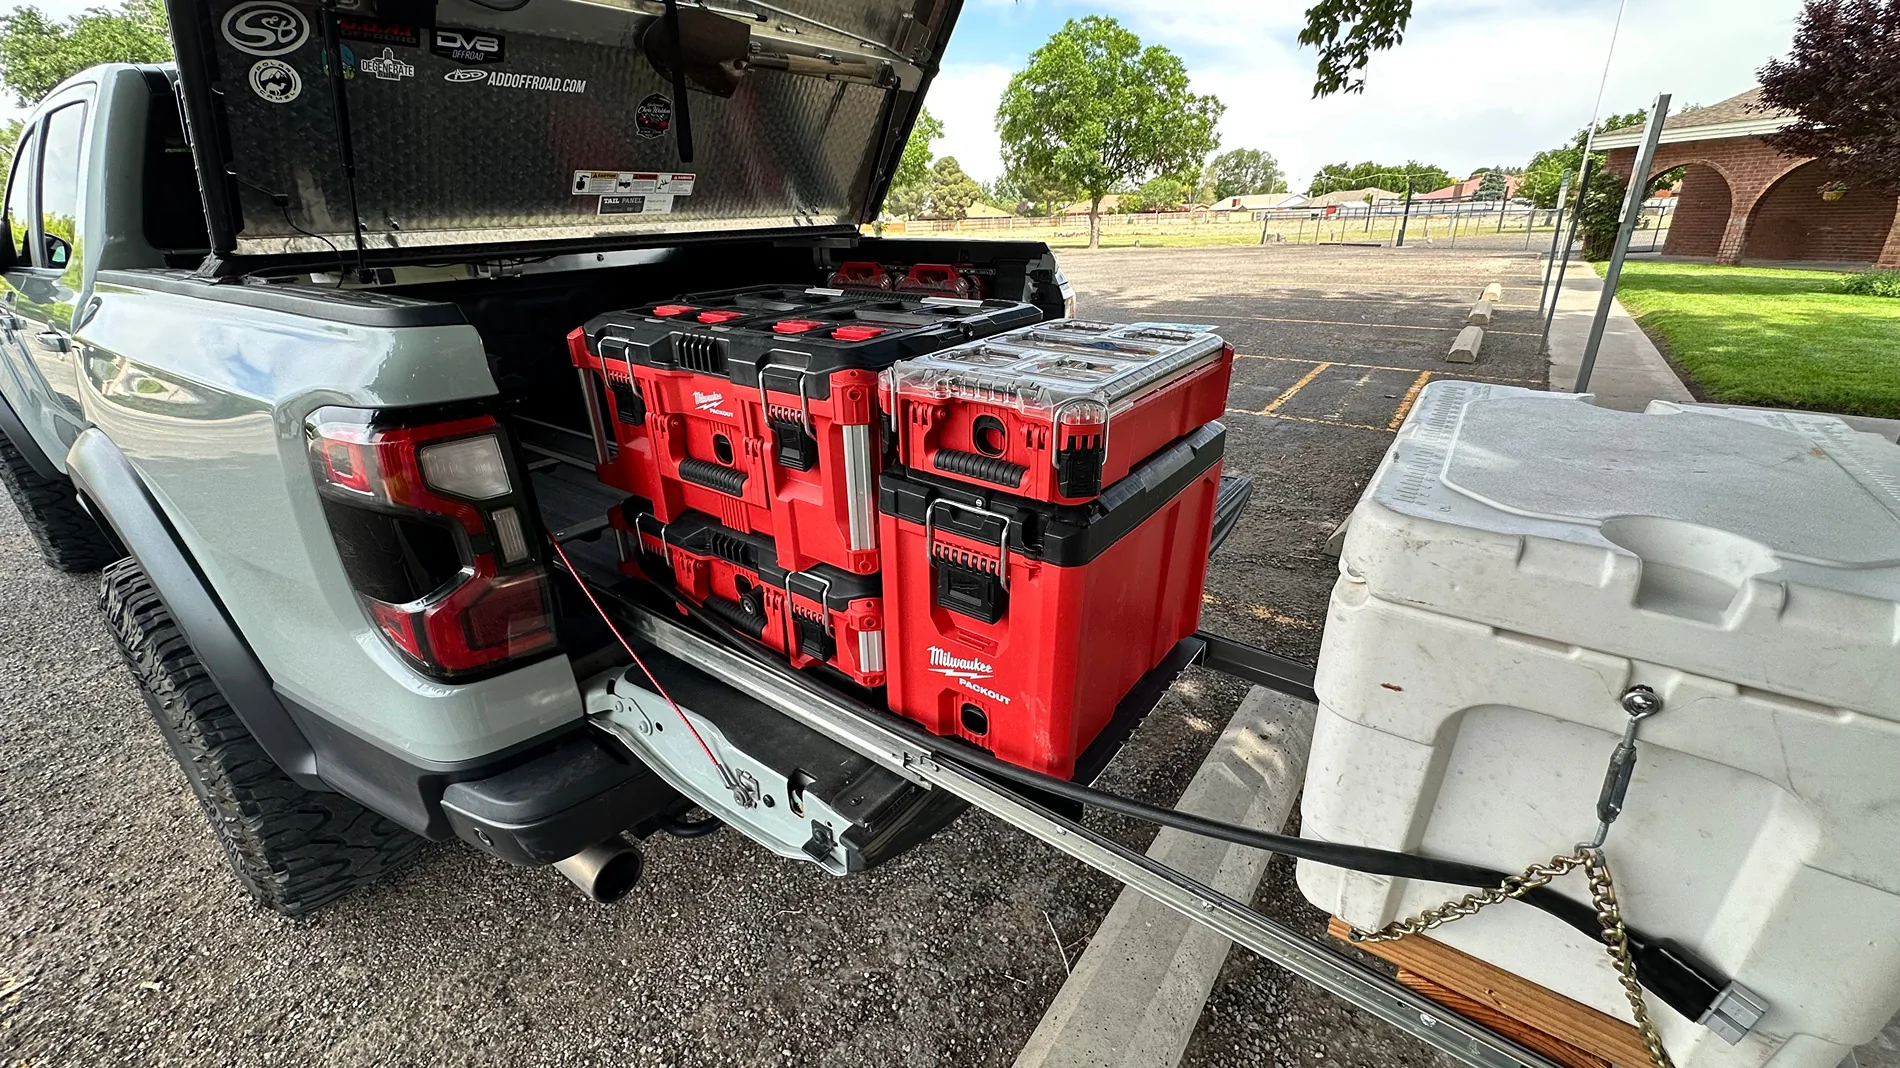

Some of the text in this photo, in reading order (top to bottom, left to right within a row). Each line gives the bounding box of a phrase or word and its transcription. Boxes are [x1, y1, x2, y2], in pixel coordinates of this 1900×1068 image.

[437, 31, 499, 52] DV8
[452, 50, 484, 61] OFFROAD
[256, 61, 292, 73] POLAR
[362, 60, 413, 76] DEGENERATE
[487, 72, 587, 94] ADDOFFROAD.COM
[260, 90, 296, 101] CAMEL
[926, 645, 994, 674] Milwaukee
[958, 678, 1012, 705] PACKOUT
